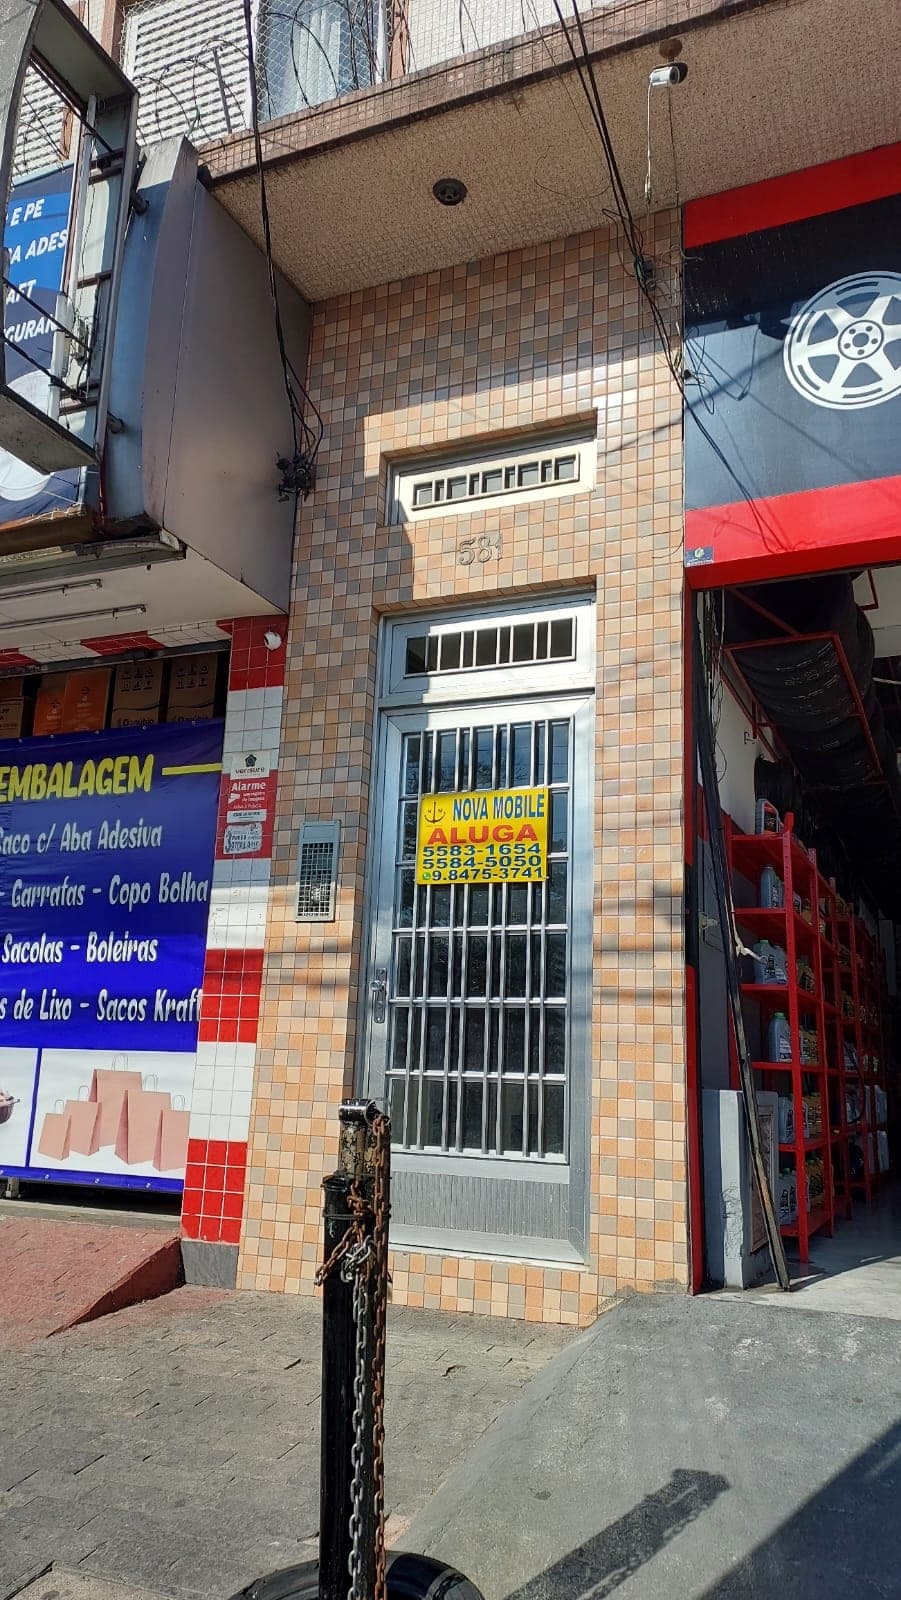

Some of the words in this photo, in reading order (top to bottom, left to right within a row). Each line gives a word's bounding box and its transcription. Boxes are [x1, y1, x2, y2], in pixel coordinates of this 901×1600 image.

[24, 198, 45, 222] PE
[25, 229, 68, 260] ADES
[0, 754, 154, 802] EMBALAGEM
[231, 781, 266, 791] Alarme
[453, 796, 488, 821] NOVA
[493, 794, 545, 819] MOBILE
[37, 823, 56, 854] c/
[60, 822, 92, 851] Aba
[98, 818, 163, 849] Adesiva
[428, 824, 538, 845] ALUGA
[422, 855, 541, 869] 5584-5050
[423, 843, 541, 857] 5583-1654
[432, 867, 543, 881] 9.8475-3741
[11, 876, 85, 908] Garrafas
[109, 874, 151, 912] Copo
[159, 872, 209, 903] Bolha
[2, 932, 63, 964] Sacolas
[86, 931, 158, 963] Boleiras
[14, 988, 34, 1020] de
[40, 988, 72, 1020] Lixo
[97, 988, 147, 1022] Sacos
